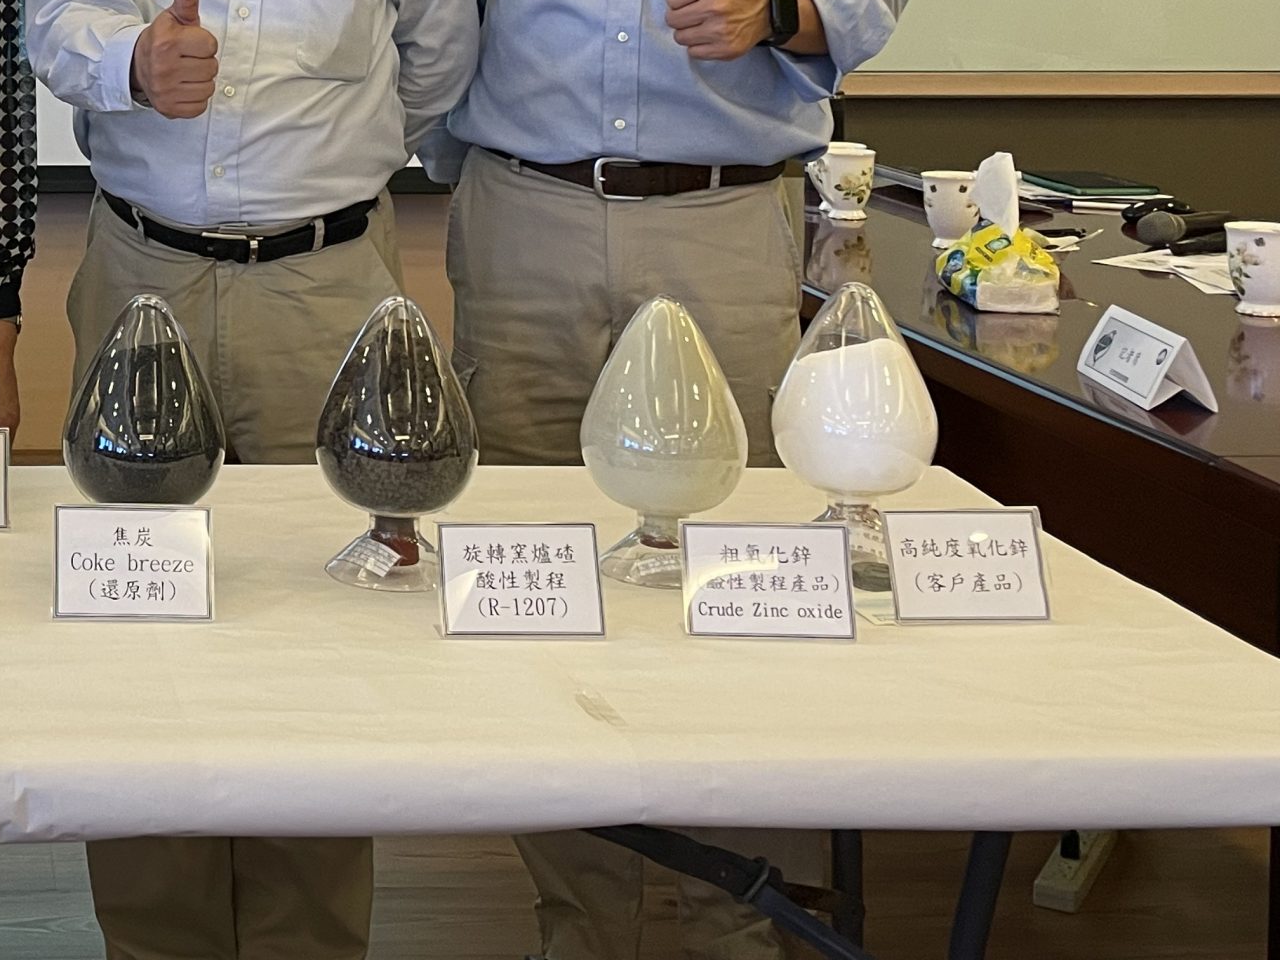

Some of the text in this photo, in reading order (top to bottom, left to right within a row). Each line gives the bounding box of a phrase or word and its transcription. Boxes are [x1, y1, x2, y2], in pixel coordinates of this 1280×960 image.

[112, 526, 154, 548] 焦炭
[900, 537, 1029, 558] 高純度氧化鋅
[70, 552, 195, 573] Coke breeze
[88, 578, 177, 602] (還原劑)
[476, 569, 567, 591] 酸性製程
[914, 571, 1023, 593] (客戶產品)
[477, 597, 569, 618] (R-1207)
[698, 601, 844, 619] Crude Zinc oxide
